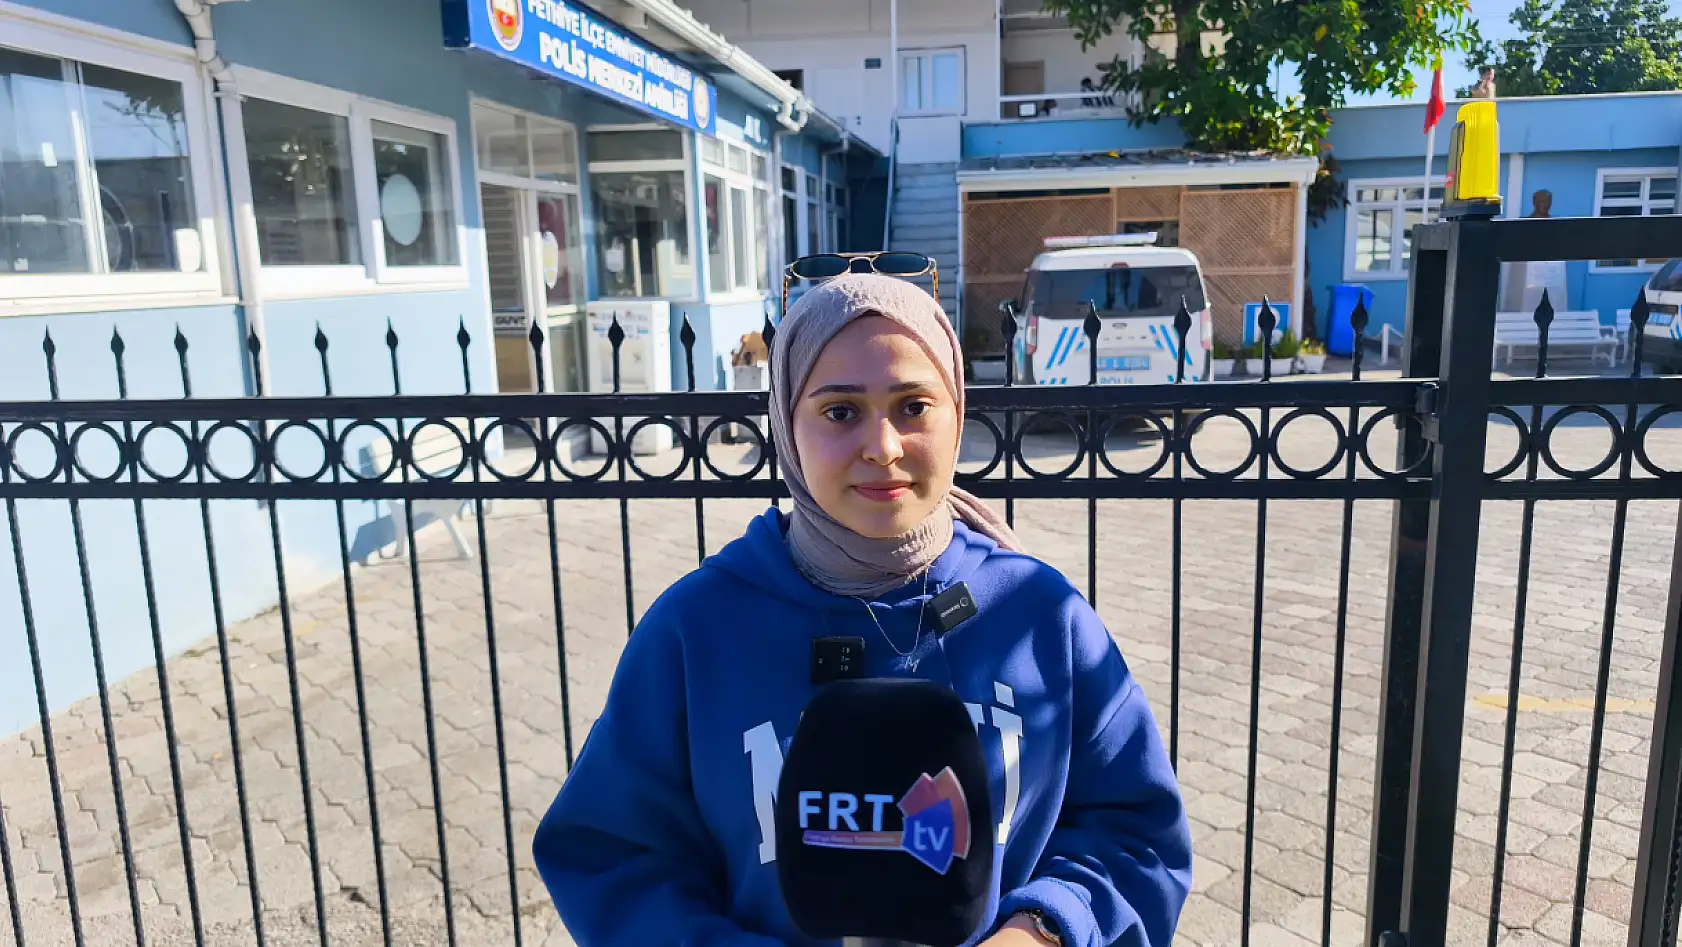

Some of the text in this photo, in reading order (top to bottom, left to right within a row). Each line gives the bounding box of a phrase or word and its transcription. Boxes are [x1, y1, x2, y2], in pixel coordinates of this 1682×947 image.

[539, 32, 587, 79] POLİS
[798, 790, 949, 851] FRT tv
